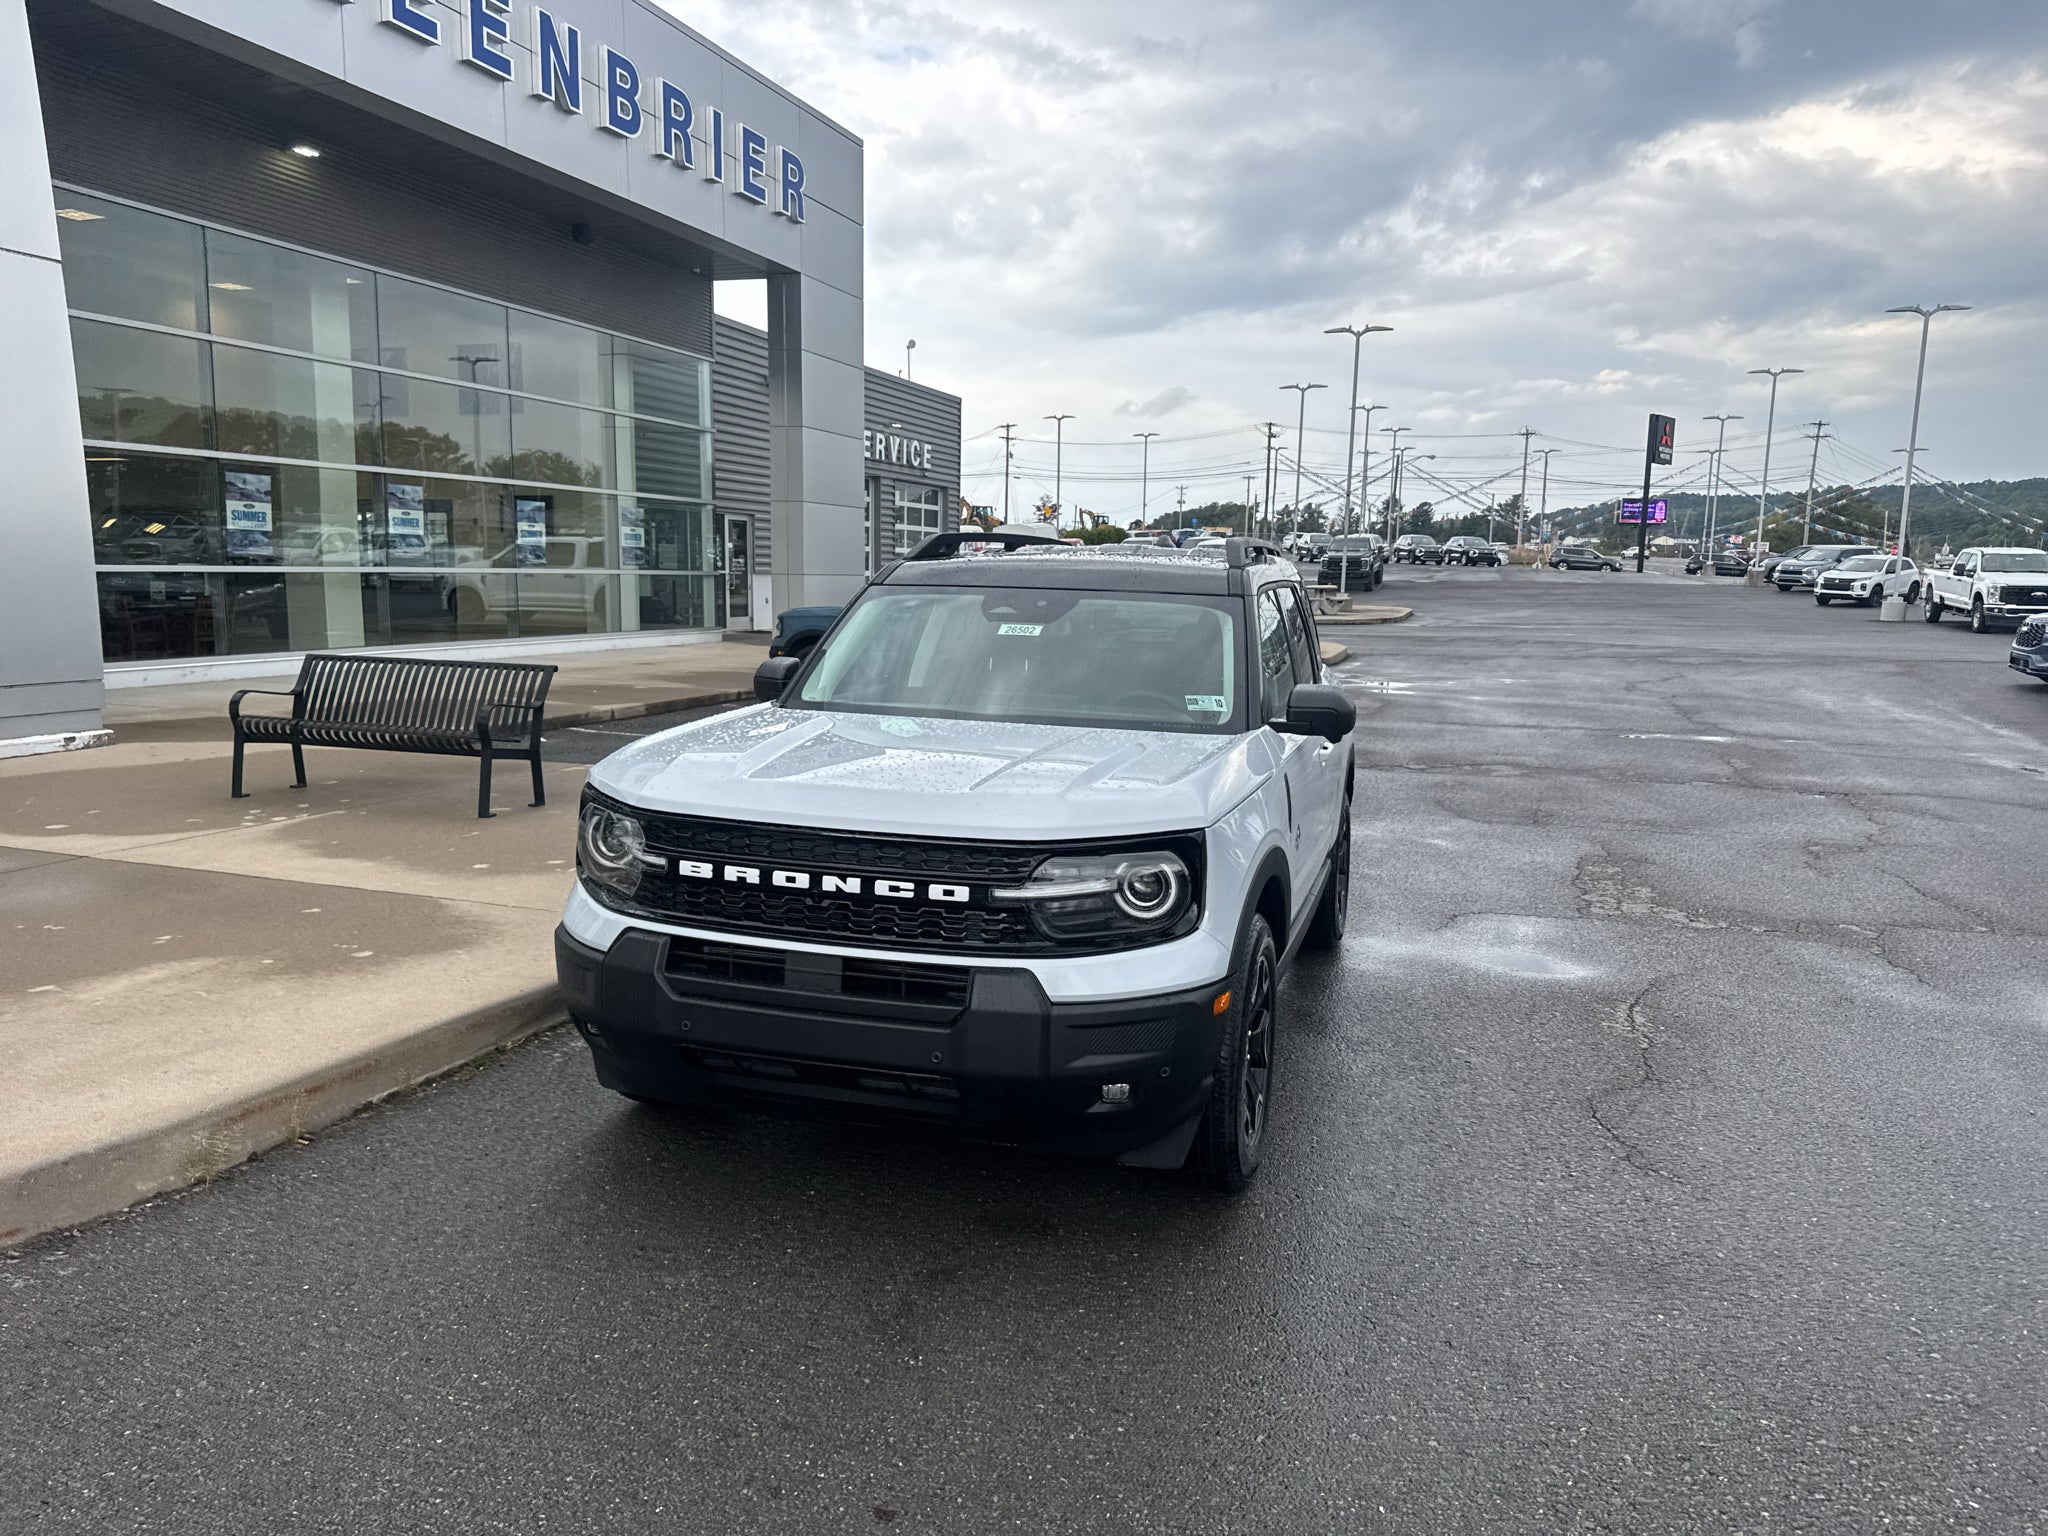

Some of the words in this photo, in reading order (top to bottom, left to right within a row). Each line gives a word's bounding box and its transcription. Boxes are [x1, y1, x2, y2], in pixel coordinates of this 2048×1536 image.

[231, 509, 267, 522] SUMMER
[1004, 625, 1036, 635] 26502
[679, 859, 970, 902] BRONCO
